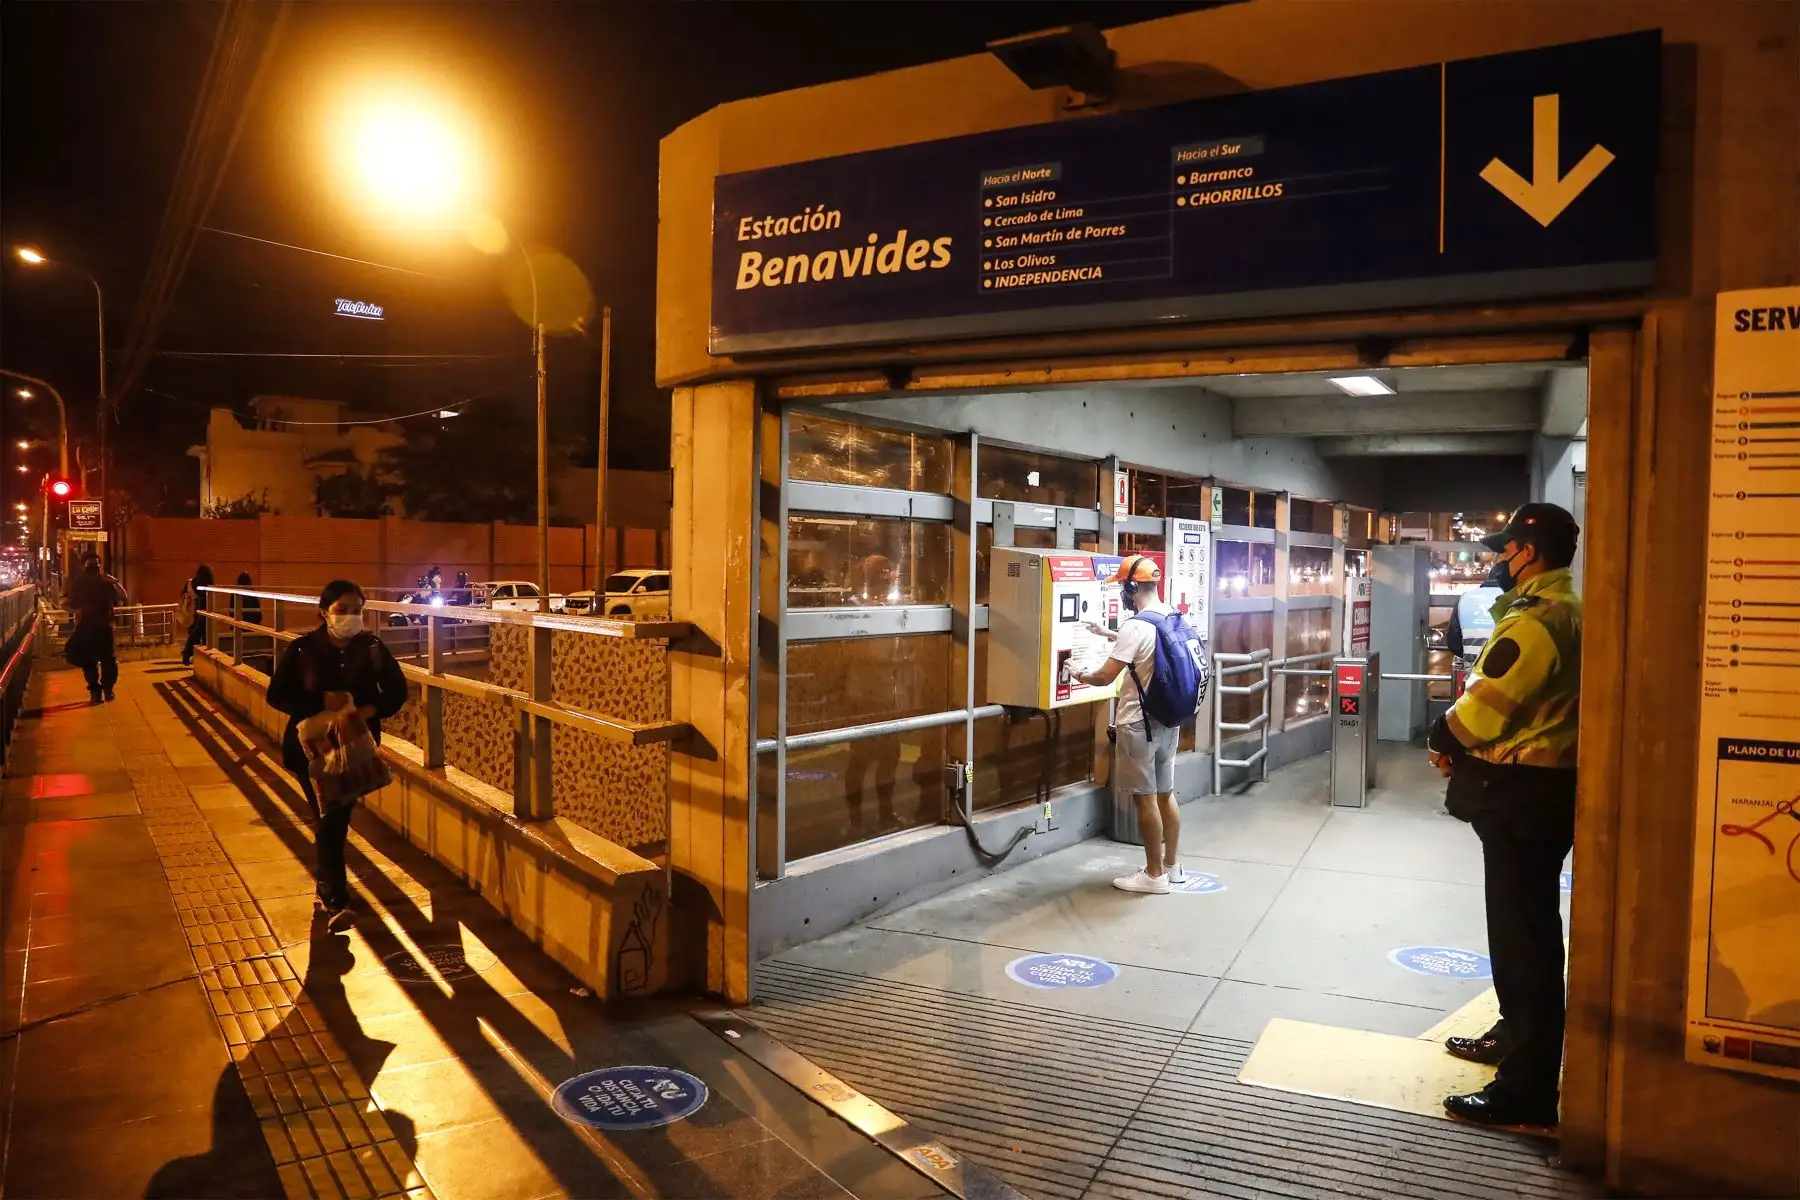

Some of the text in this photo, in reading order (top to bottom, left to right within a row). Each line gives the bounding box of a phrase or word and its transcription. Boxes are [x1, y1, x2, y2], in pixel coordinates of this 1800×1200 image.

[1177, 143, 1241, 161] Hacia el Sur
[983, 167, 1052, 186] Hacia el Norte
[1189, 166, 1253, 185] Barranco
[995, 189, 1056, 208] San Isidro
[1189, 183, 1283, 206] CHORRILLOS
[737, 204, 841, 242] Estación
[994, 207, 1084, 227] Cercado de Lima
[995, 224, 1126, 248] San Martín de Porres
[735, 228, 953, 290] Benavides
[994, 254, 1056, 271] Los Olivos
[994, 266, 1103, 289] INDEPENDENCIA
[1734, 306, 1800, 333] SERV
[1727, 745, 1767, 756] PLANO
[1769, 748, 1785, 757] DE
[1731, 797, 1774, 807] NARANJAL
[578, 1094, 601, 1113] VIDA
[619, 1079, 659, 1109] CUIDA TU
[608, 1104, 626, 1116] TU
